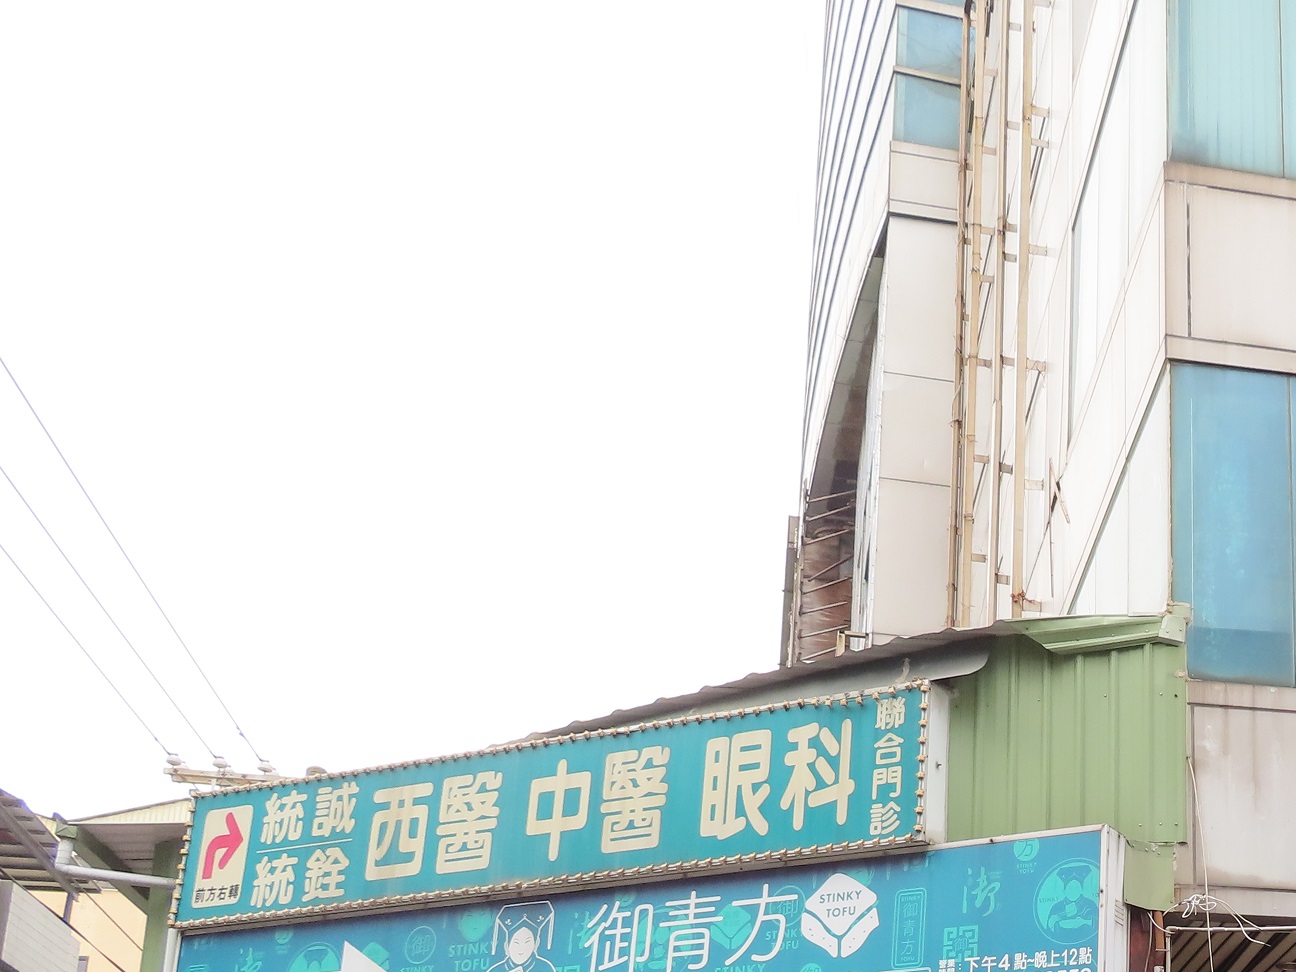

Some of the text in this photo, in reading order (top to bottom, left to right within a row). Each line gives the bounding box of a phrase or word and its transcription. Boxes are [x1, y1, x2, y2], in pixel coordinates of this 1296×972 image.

[869, 697, 906, 836] 聯合門診
[260, 781, 360, 845] 統誠
[365, 718, 855, 881] 西醫 中醫 眼科
[195, 884, 240, 902] 前方右轉
[250, 847, 349, 909] 統銓
[819, 890, 862, 905] STINKY
[826, 905, 857, 919] TOFU
[454, 956, 491, 972] TOFU
